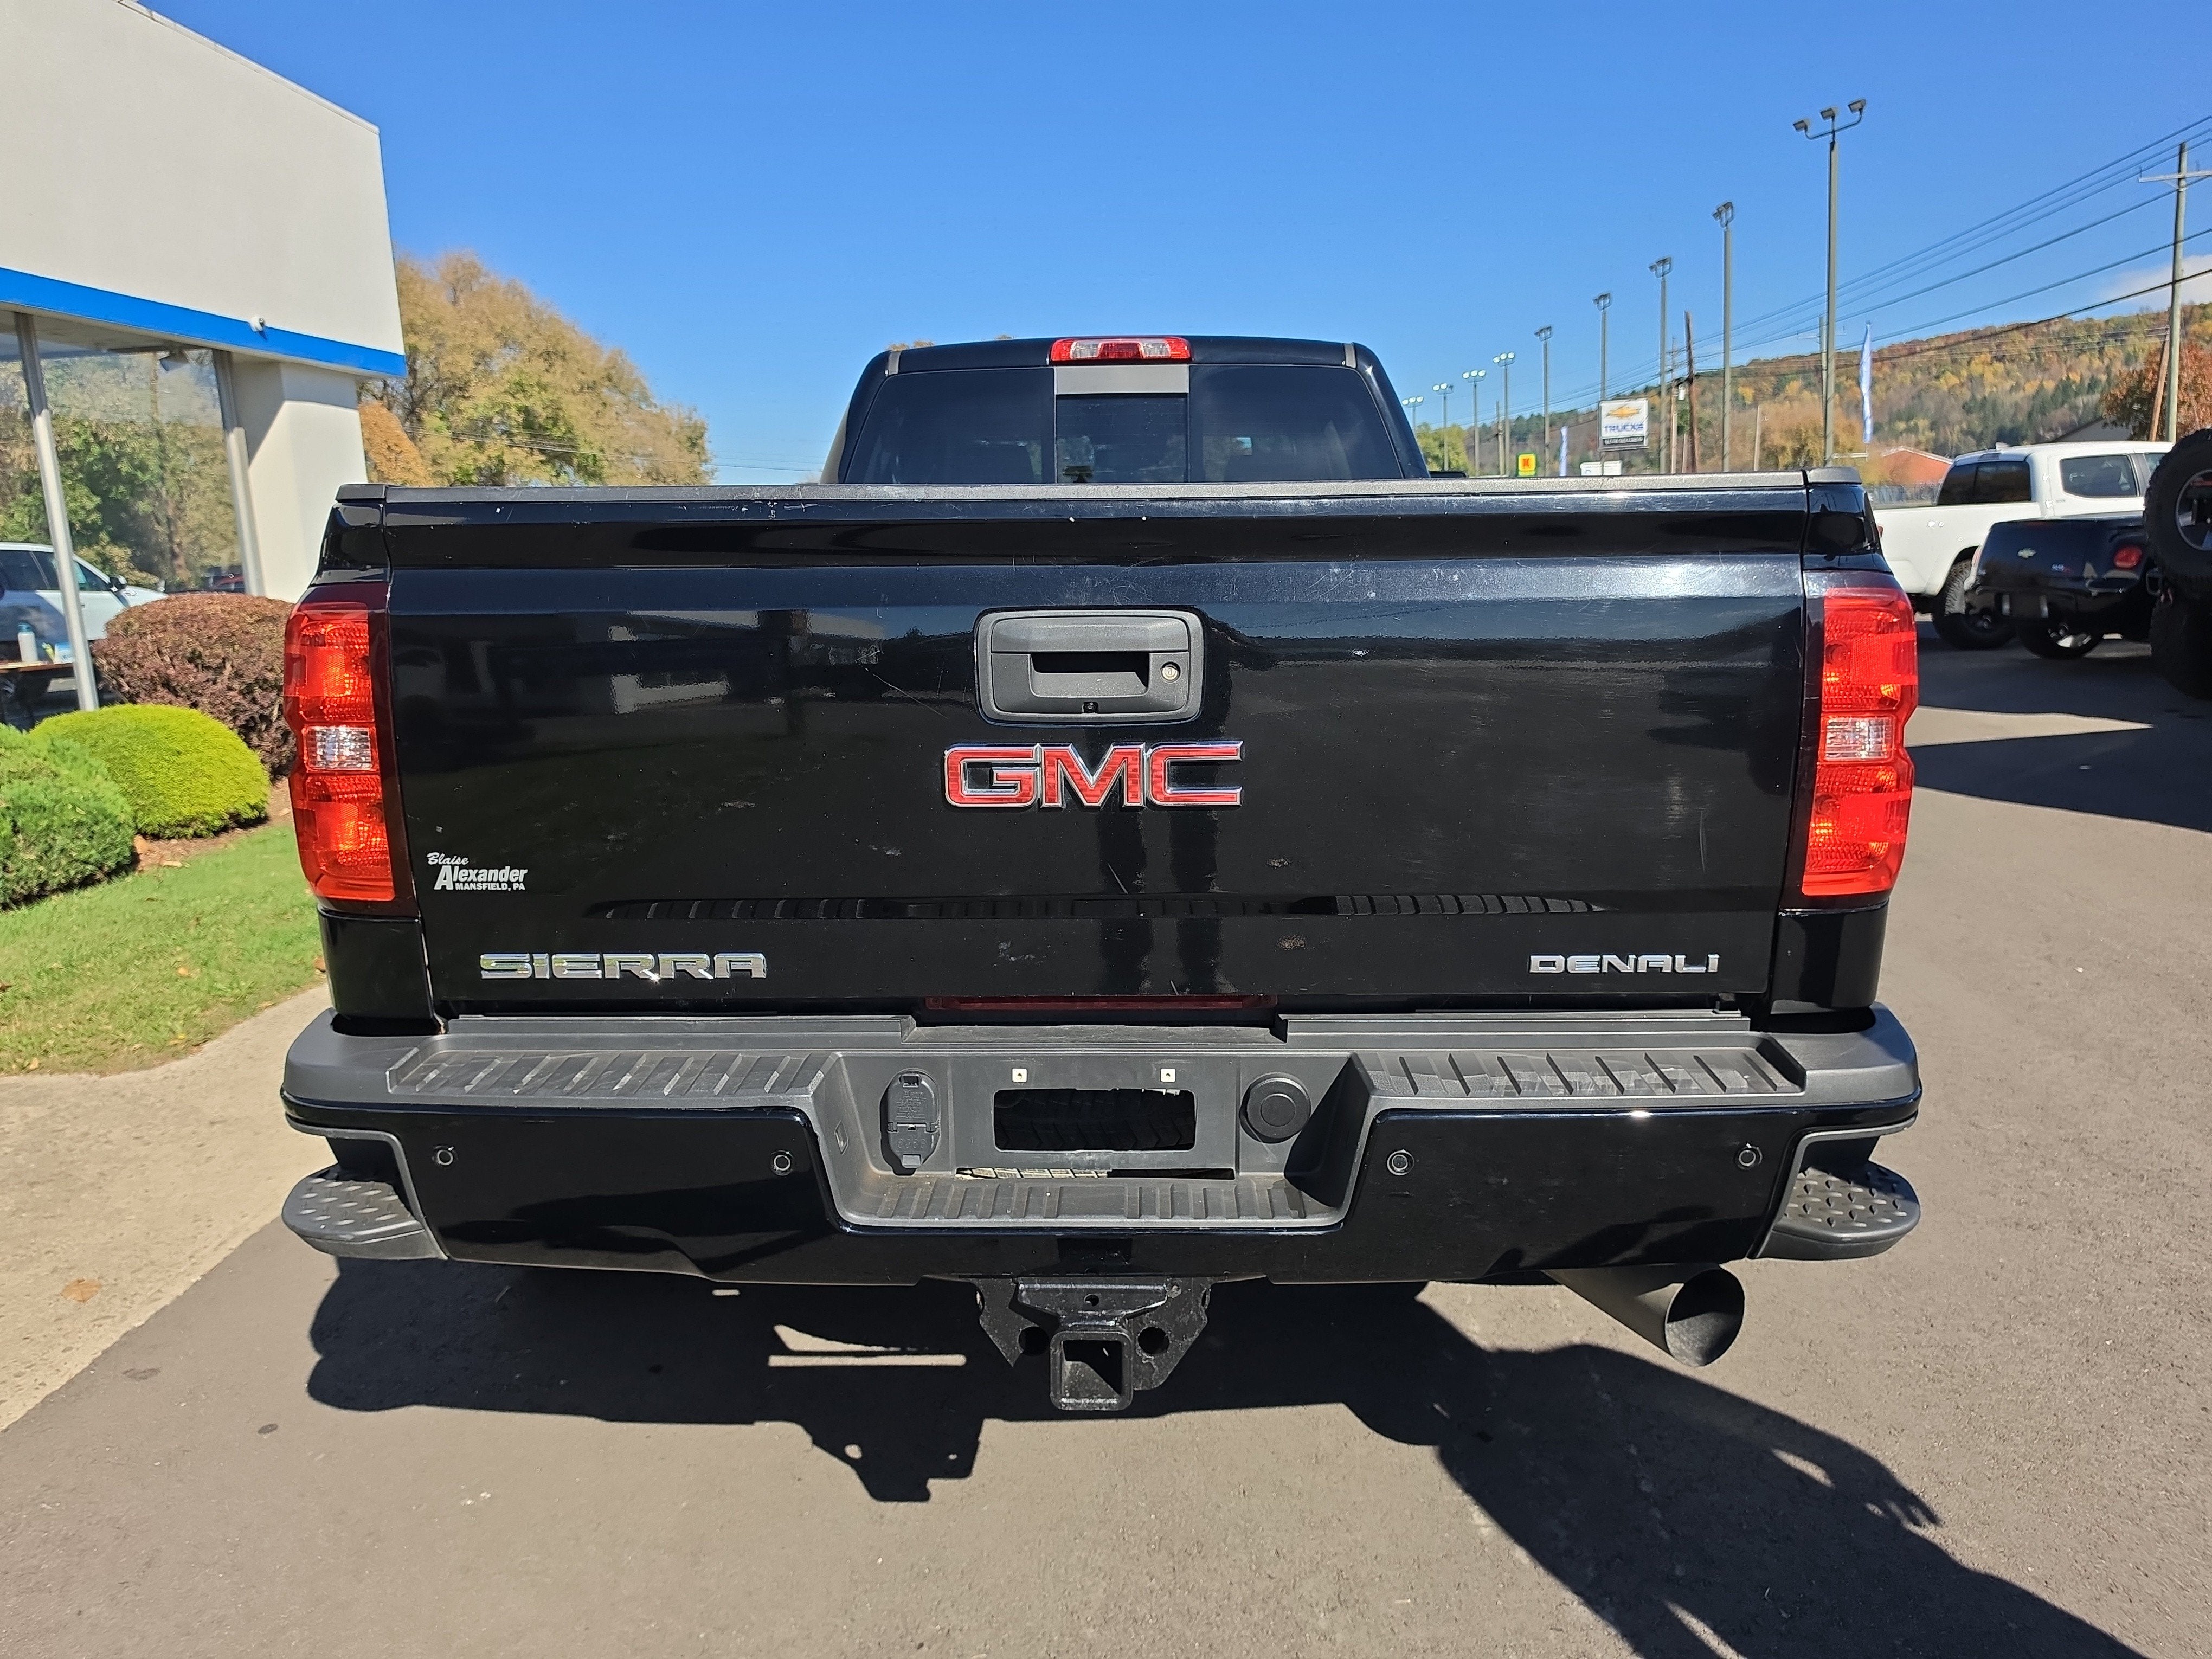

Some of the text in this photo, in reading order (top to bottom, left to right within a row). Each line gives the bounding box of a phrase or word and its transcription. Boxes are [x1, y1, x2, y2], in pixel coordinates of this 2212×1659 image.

[1604, 423, 1643, 433] TRUCKS
[943, 740, 1243, 807] GMC
[427, 852, 469, 865] Blaise
[434, 865, 528, 890] Alexander
[455, 883, 511, 892] MANSFIELD,
[480, 953, 767, 979] SIERRA
[1529, 954, 1720, 973] DENALI
